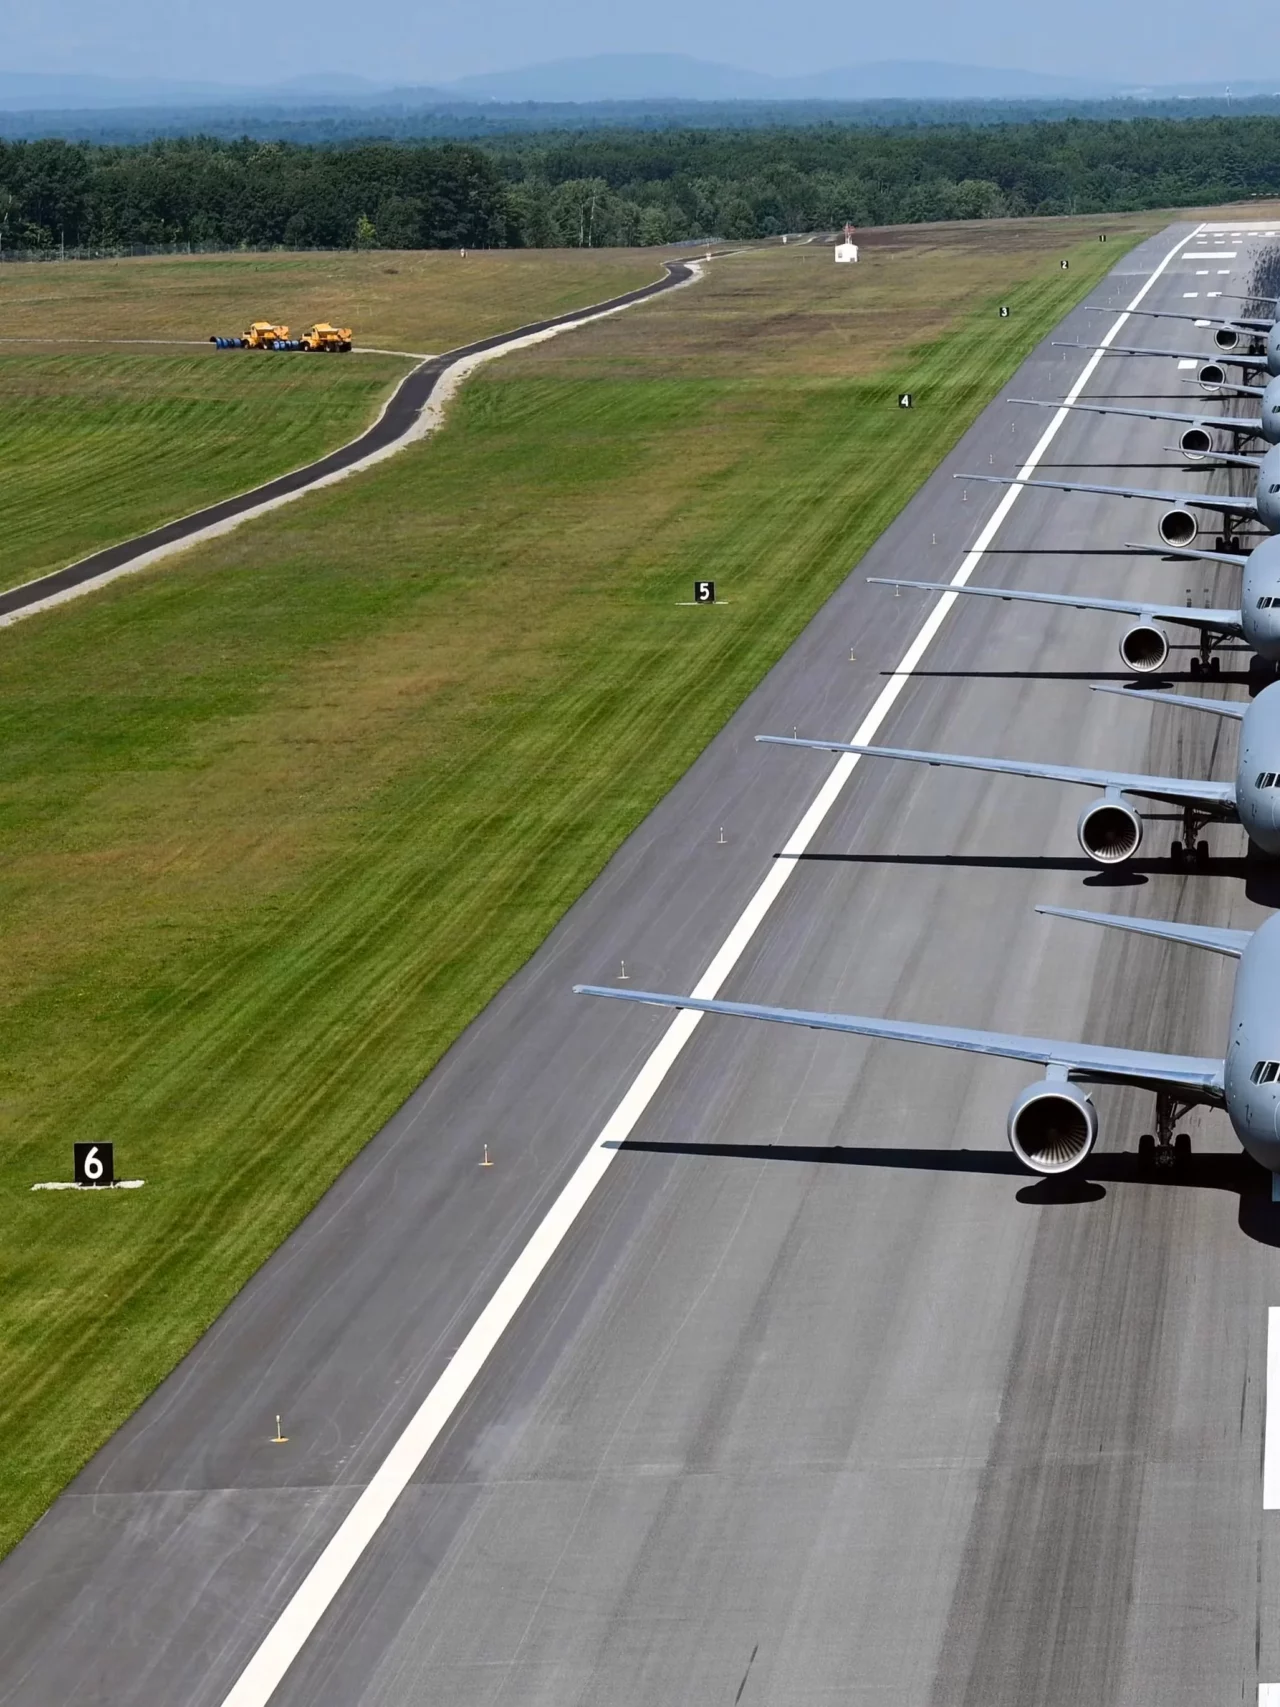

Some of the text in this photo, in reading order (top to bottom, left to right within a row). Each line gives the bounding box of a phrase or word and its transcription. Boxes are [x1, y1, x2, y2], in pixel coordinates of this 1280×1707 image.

[900, 394, 909, 407] 4
[699, 582, 710, 601] 5
[84, 1146, 104, 1180] 6
